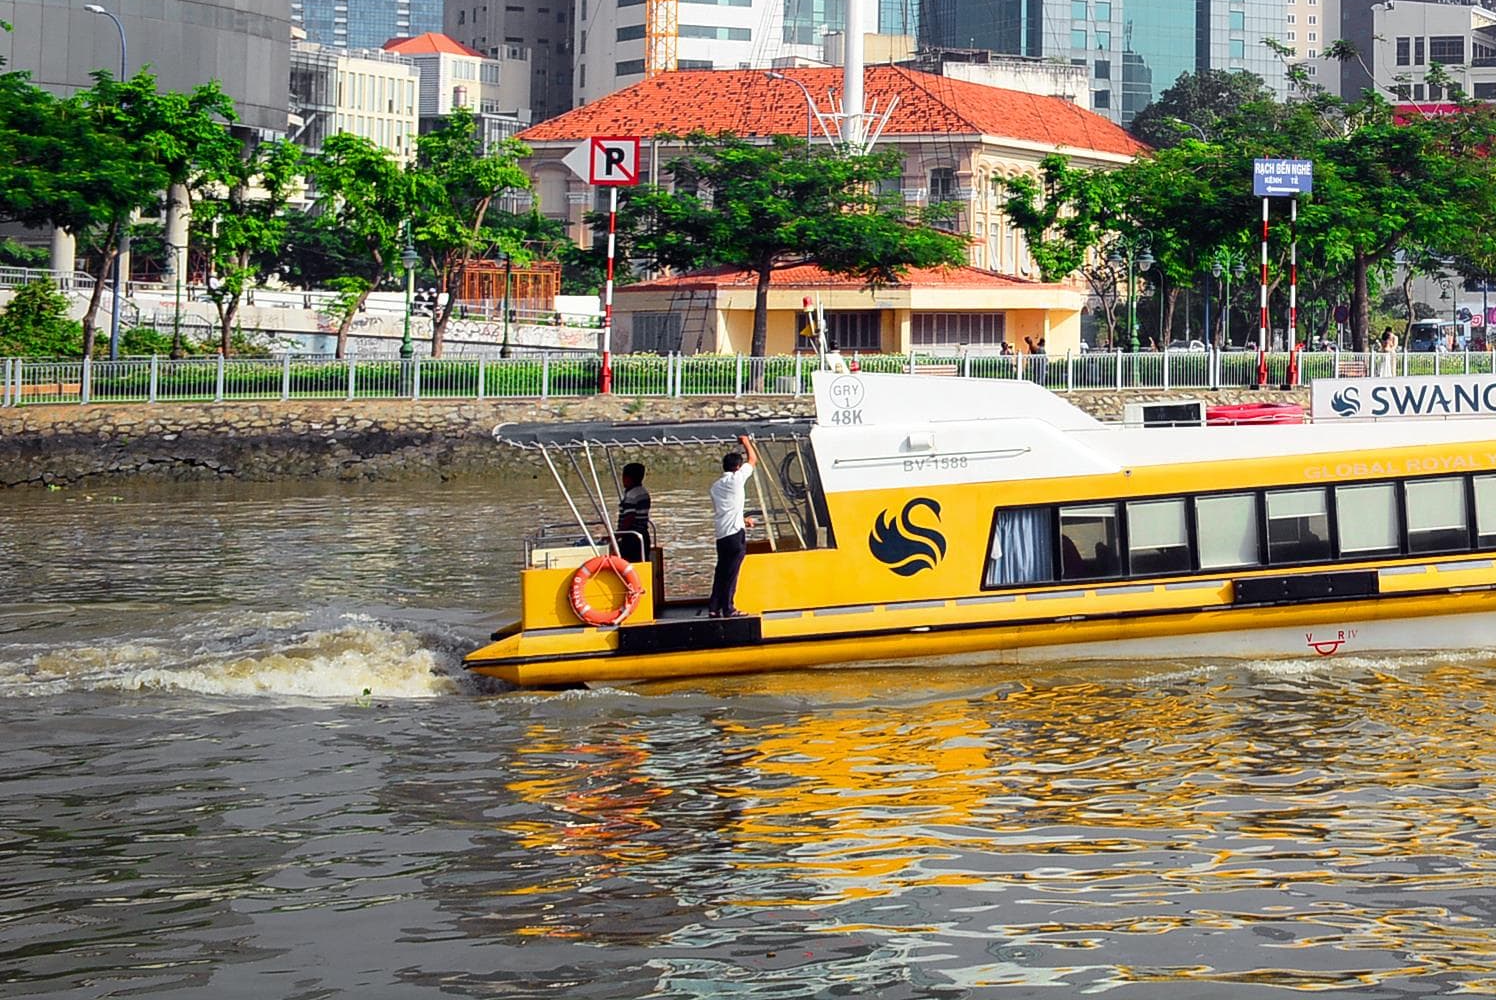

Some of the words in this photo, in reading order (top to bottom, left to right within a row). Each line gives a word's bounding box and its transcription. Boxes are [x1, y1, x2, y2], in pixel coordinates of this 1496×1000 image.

[833, 384, 859, 396] GRY
[831, 409, 863, 424] 48K
[903, 456, 968, 472] BV-1588
[1303, 461, 1402, 480] GLOBAL
[1405, 454, 1481, 472] ROYAL
[1338, 630, 1345, 640] R
